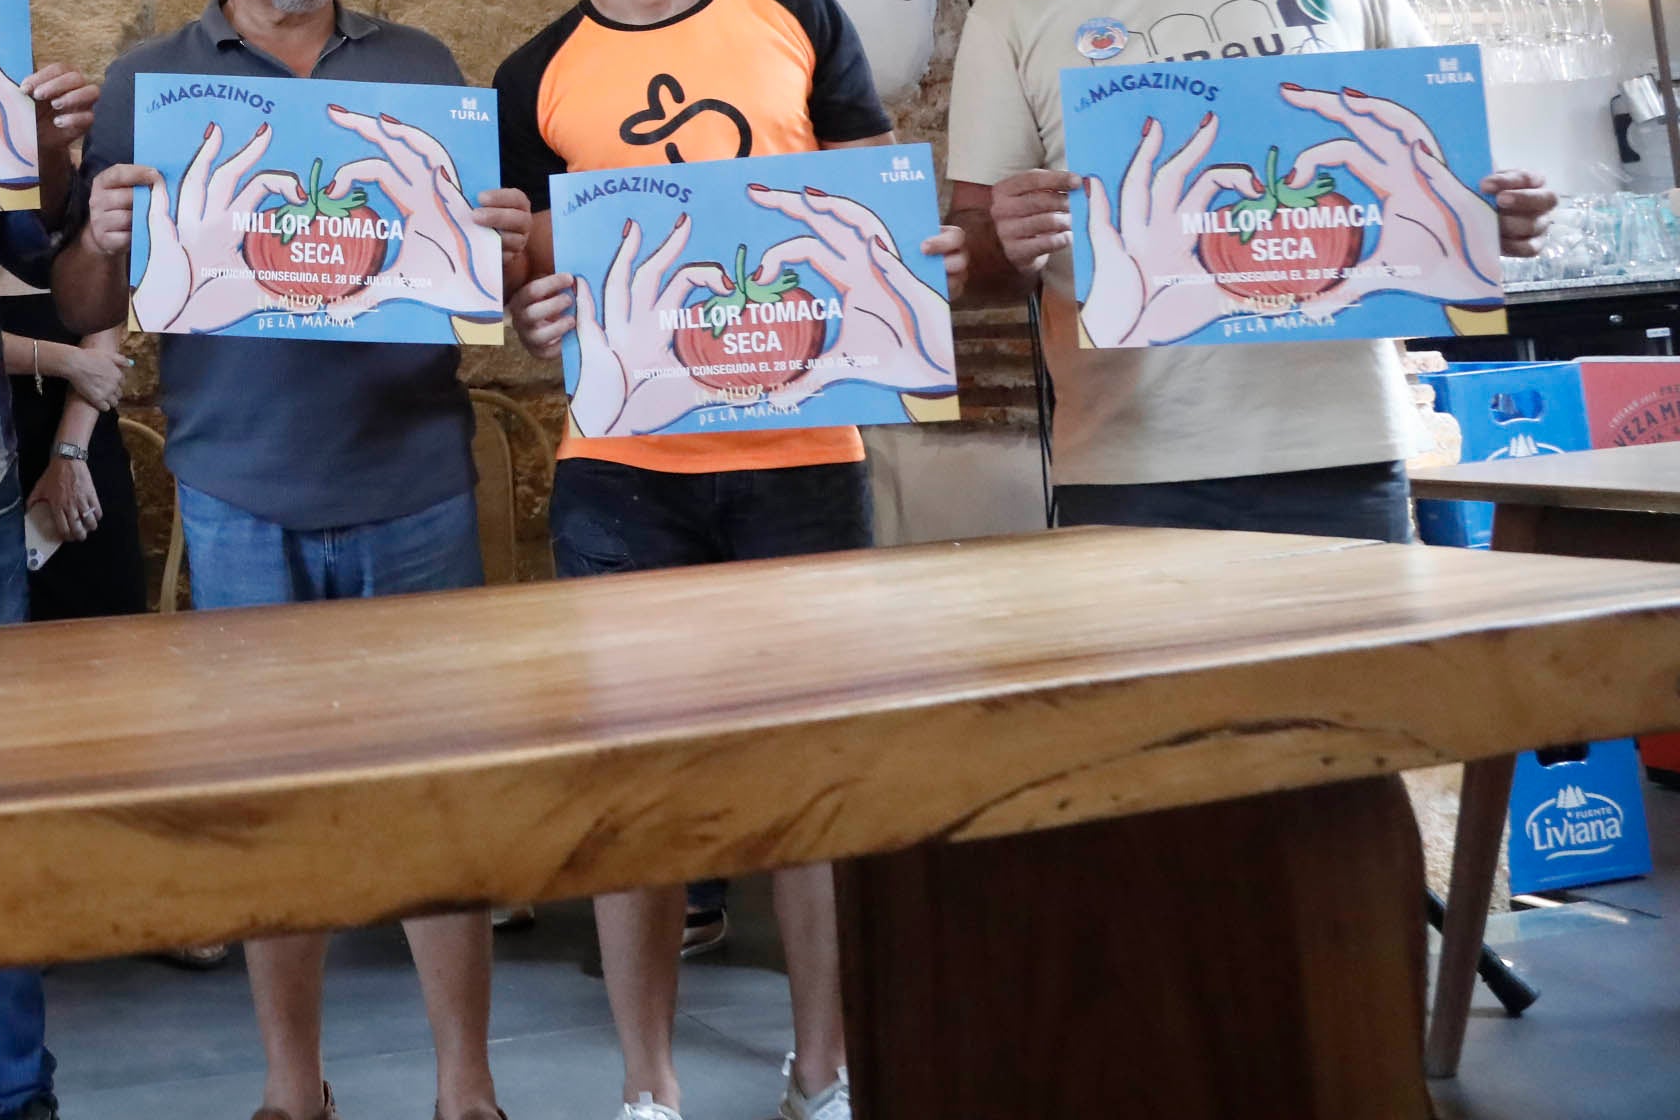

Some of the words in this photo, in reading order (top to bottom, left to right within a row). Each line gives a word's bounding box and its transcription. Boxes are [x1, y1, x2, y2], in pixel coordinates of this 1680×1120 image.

[1089, 73, 1217, 103] MAGAZINOS
[1425, 72, 1474, 85] TURIA
[160, 84, 275, 115] MAGAZINOS
[450, 109, 490, 122] TURIA
[880, 170, 925, 182] TURIA
[575, 177, 692, 207] MAGAZINOS
[233, 212, 311, 235] MILLOR
[316, 216, 404, 240] TOMACA
[1182, 208, 1273, 234] MILLOR
[1279, 204, 1383, 229] TOMACA
[290, 242, 344, 264] SECA
[1251, 237, 1316, 261] SECA
[258, 271, 318, 282] CONSEGUIDA
[259, 317, 273, 329] DE
[279, 314, 295, 328] LA
[659, 305, 741, 330] MILLOR
[749, 299, 843, 324] TOMACA
[723, 331, 782, 354] SECA
[693, 362, 756, 376] CONSEGUIDA
[700, 414, 714, 426] DE
[720, 408, 737, 421] LA
[1576, 807, 1612, 818] FUENTE
[1532, 809, 1622, 851] Liviana
